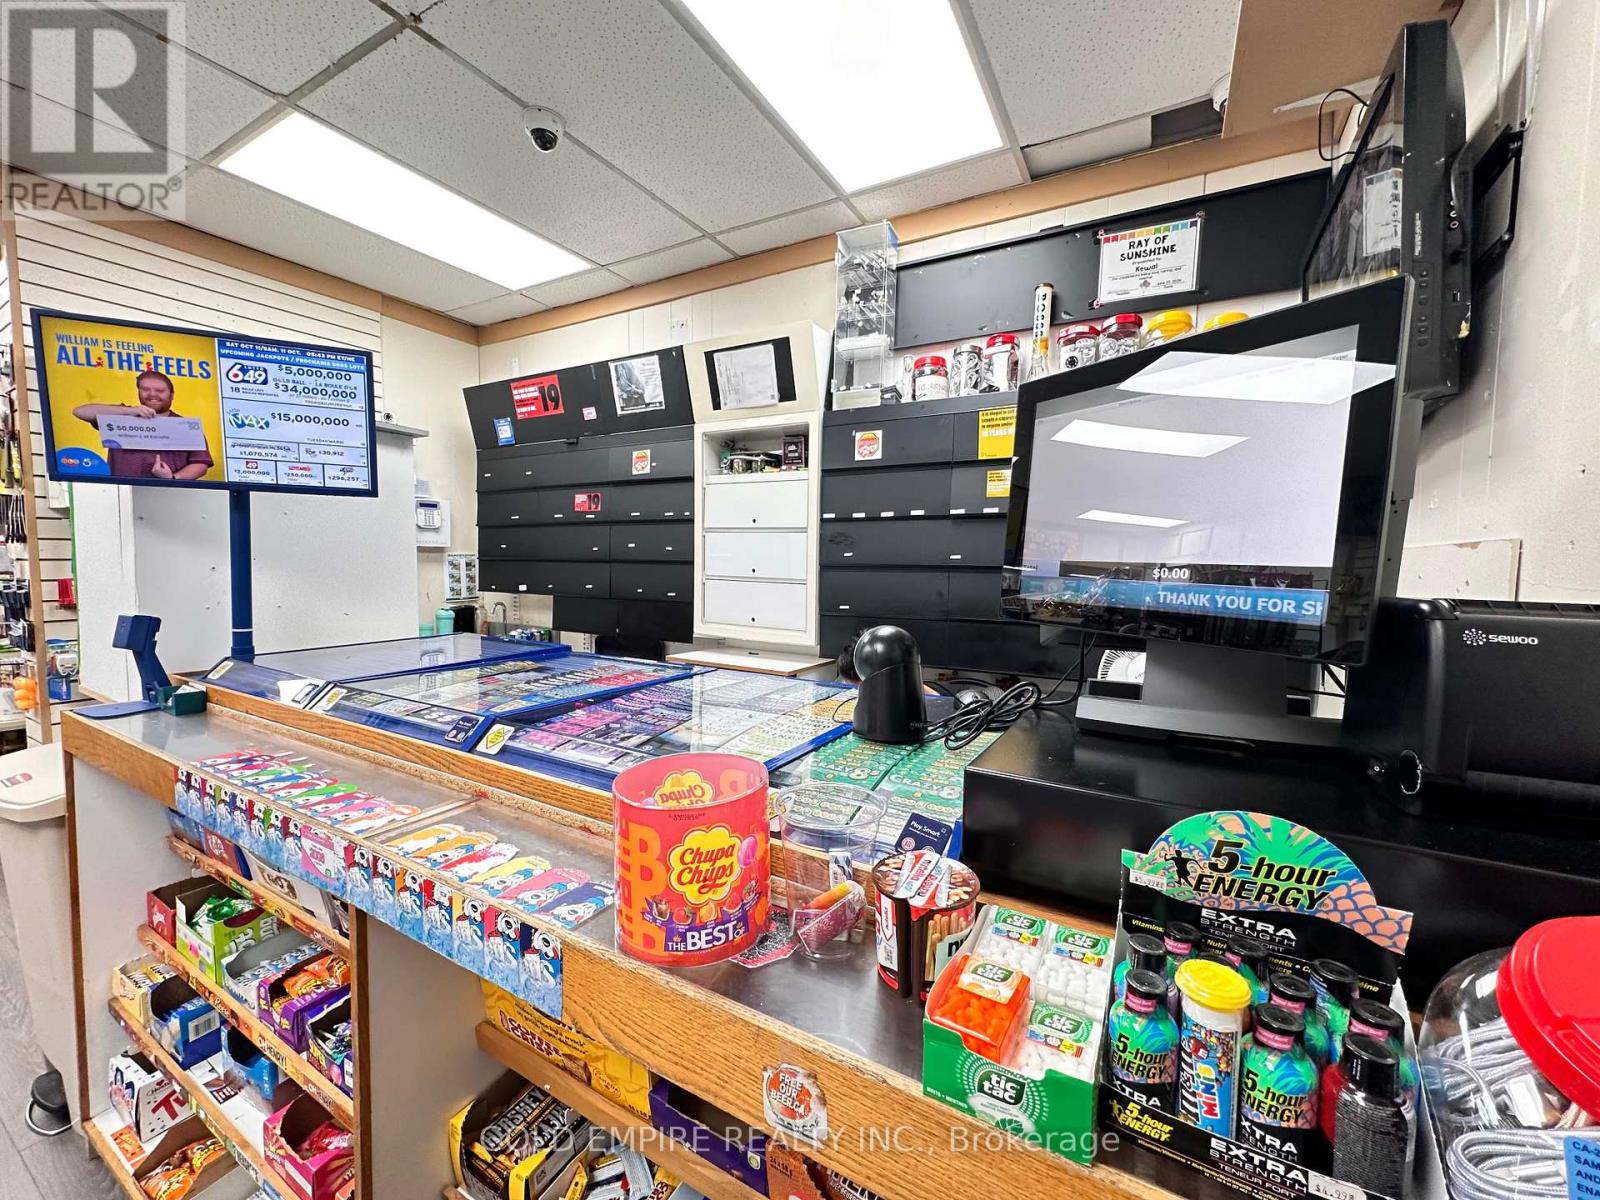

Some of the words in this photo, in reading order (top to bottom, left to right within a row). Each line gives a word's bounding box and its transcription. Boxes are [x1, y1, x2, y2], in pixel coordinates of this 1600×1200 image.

[1120, 244, 1176, 261] SUNSHINE
[1129, 238, 1150, 250] RAY
[1154, 235, 1168, 245] OF
[56, 332, 99, 347] WILLIAM
[103, 339, 112, 348] IS
[116, 340, 154, 353] FEELING
[220, 349, 254, 358] UPCOMING
[256, 352, 290, 362] JACKPOTS
[57, 345, 98, 367] ALL
[104, 350, 145, 372] THE
[153, 356, 211, 379] FEELS
[278, 364, 352, 382] $5,000,000
[230, 386, 240, 394] 18
[274, 382, 357, 400] $34,000,000
[538, 384, 560, 411] 19
[271, 413, 349, 427] $15,000,000
[587, 494, 600, 510] 19
[1152, 568, 1188, 579] $0.00
[1158, 591, 1210, 607] THANK
[1214, 594, 1250, 611] YOU
[1257, 598, 1296, 613] FOR
[889, 774, 939, 791] CRAZY
[679, 843, 736, 867] Chupa
[1208, 839, 1337, 887] 5-hour
[676, 861, 734, 894] Chups
[1193, 874, 1331, 912] ENERGY
[667, 942, 686, 951] THE
[686, 922, 737, 951] BEST
[735, 928, 745, 938] OF
[1200, 917, 1296, 948] STRENGTH
[1201, 908, 1297, 940] EXTRA
[508, 1017, 562, 1058] COFFEE
[509, 1027, 552, 1057] CRISP
[1115, 1033, 1168, 1066] 5-hour
[1113, 1052, 1165, 1080] ENERGY
[779, 1072, 803, 1090] FREE
[779, 1082, 798, 1100] OUR
[983, 1080, 1017, 1103] tac
[990, 1073, 1018, 1093] tic
[1112, 1076, 1160, 1106] XTRA
[1243, 1069, 1306, 1107] 5-hour
[770, 1089, 806, 1116] BEER.CA
[484, 1088, 545, 1148] HERSHEY
[1120, 1114, 1170, 1141] ENERGY
[1125, 1102, 1173, 1133] 5-hour
[1240, 1117, 1298, 1154] XTRA
[1209, 1149, 1307, 1194] STRENGTH
[1210, 1137, 1308, 1185] EXTRA
[1218, 1162, 1263, 1185] TENEUR
[1265, 1182, 1297, 1199] FORT
